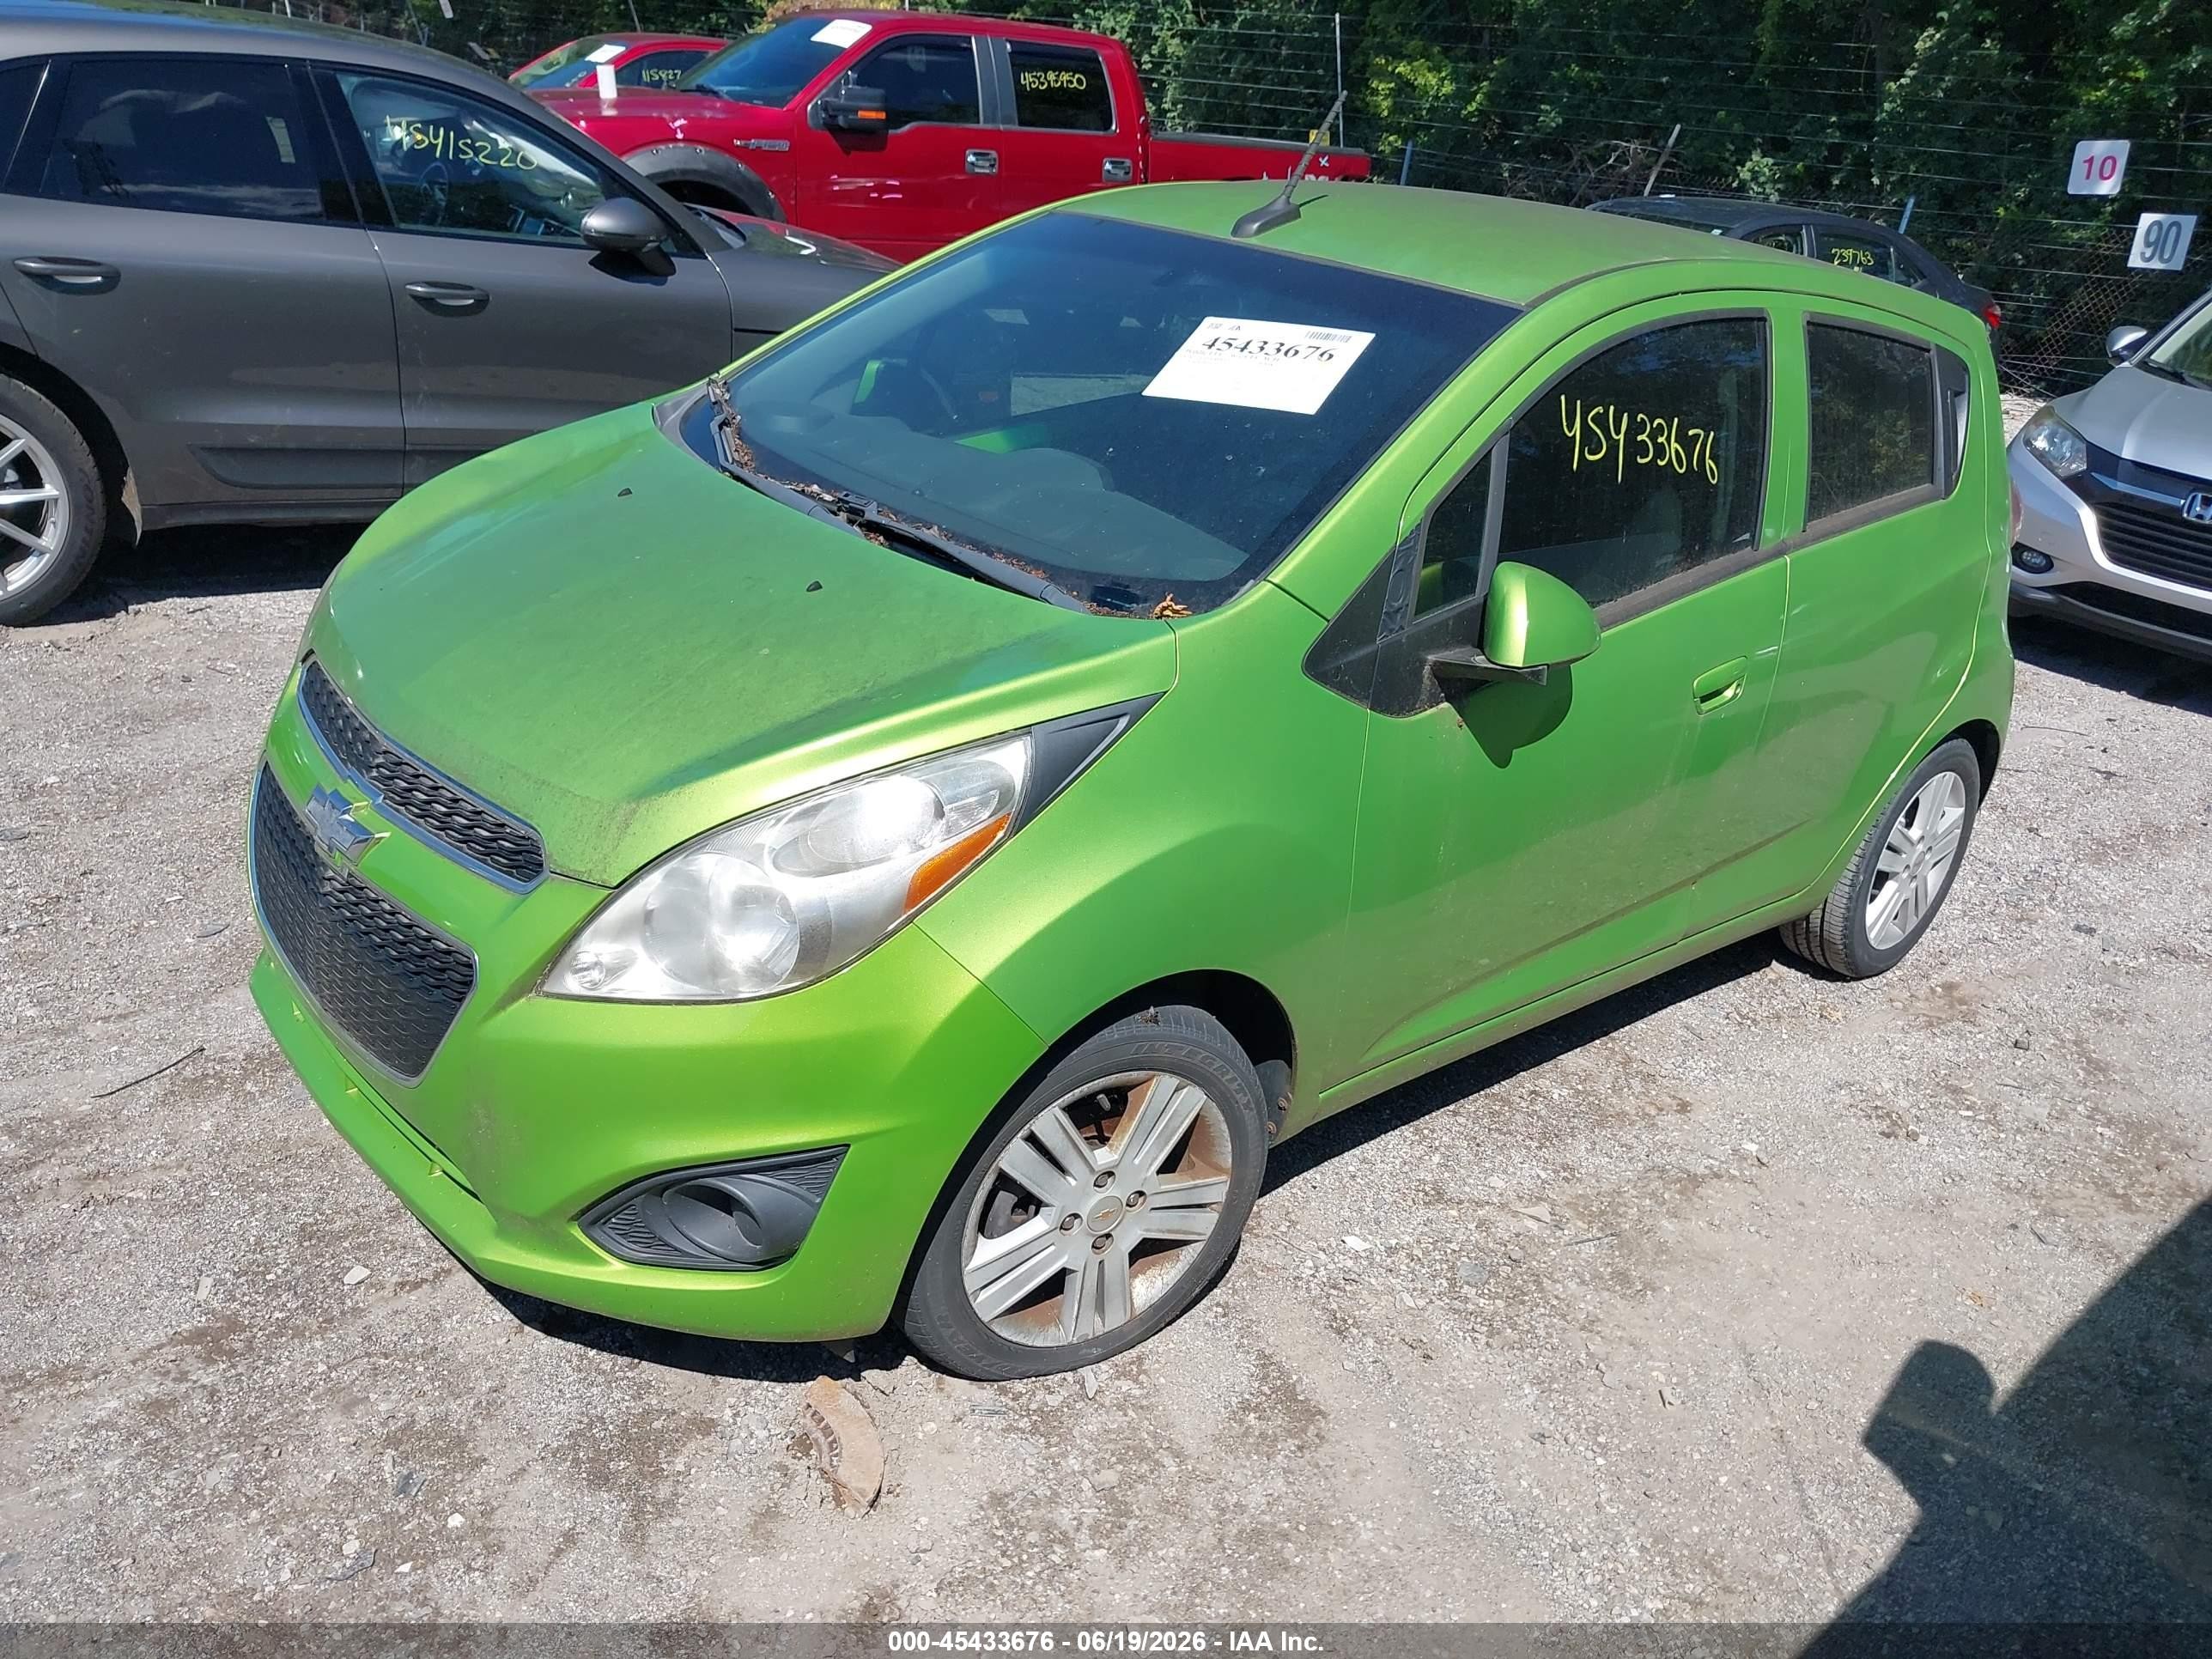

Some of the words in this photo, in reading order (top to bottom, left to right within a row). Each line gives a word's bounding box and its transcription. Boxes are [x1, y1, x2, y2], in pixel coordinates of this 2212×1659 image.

[1020, 70, 1086, 91] 45395950
[385, 115, 538, 170] 45415220
[2082, 155, 2118, 181] 10
[2140, 220, 2182, 264] 90
[1201, 336, 1339, 362] 45433676
[1560, 394, 1718, 484] 45433676
